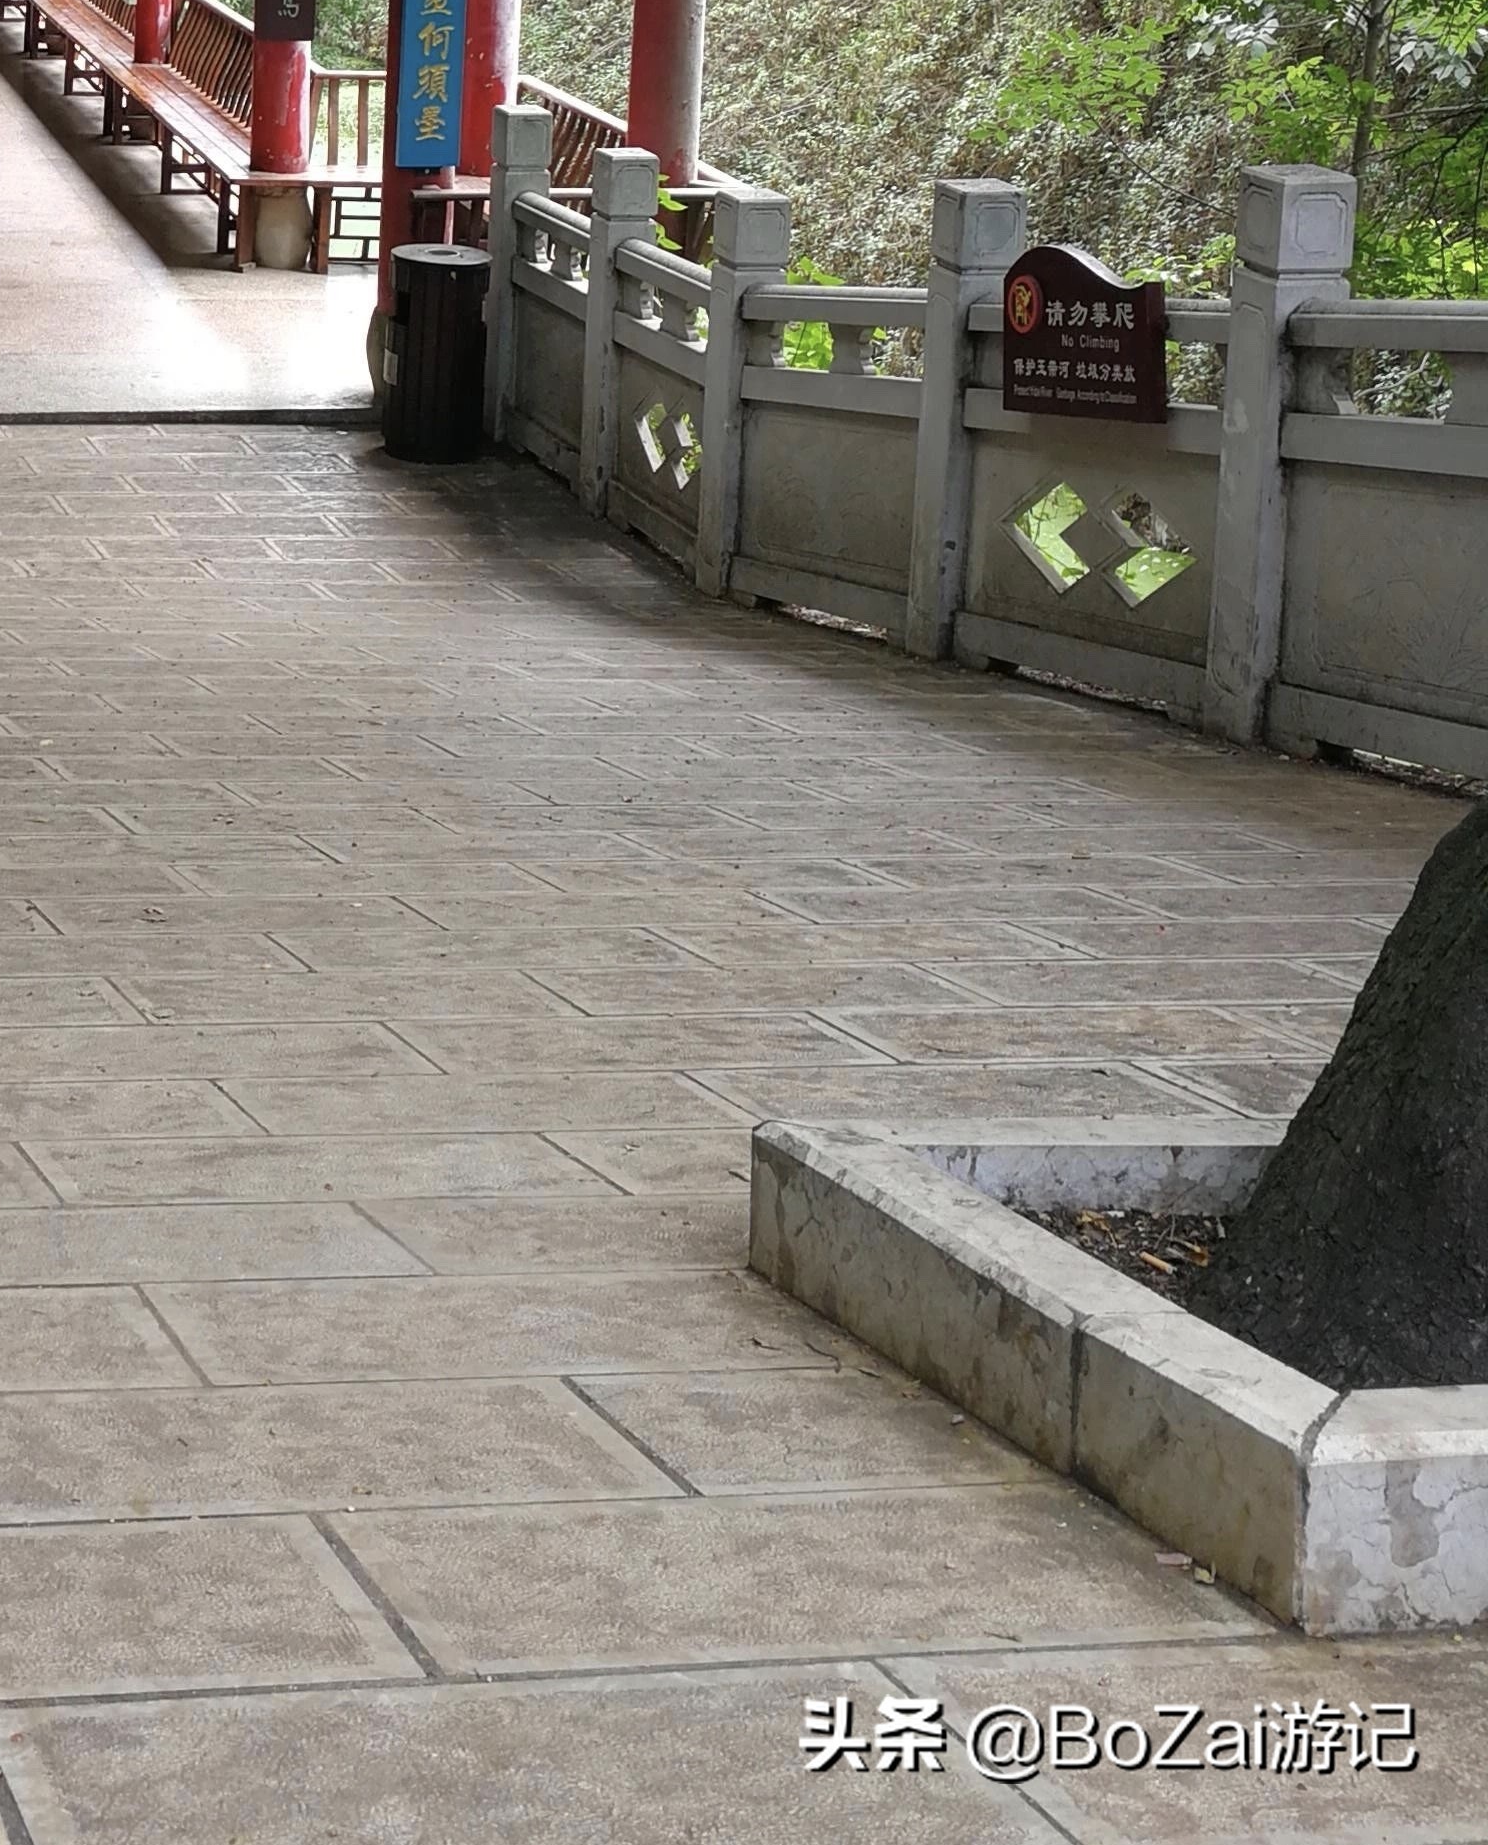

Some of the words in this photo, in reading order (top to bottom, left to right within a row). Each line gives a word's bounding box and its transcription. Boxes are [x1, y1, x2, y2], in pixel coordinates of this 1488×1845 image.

[1045, 300, 1136, 330] 请勿攀爬
[1061, 334, 1074, 347] No
[1079, 334, 1120, 352] Climbing
[1013, 358, 1071, 379] 保护玉带河
